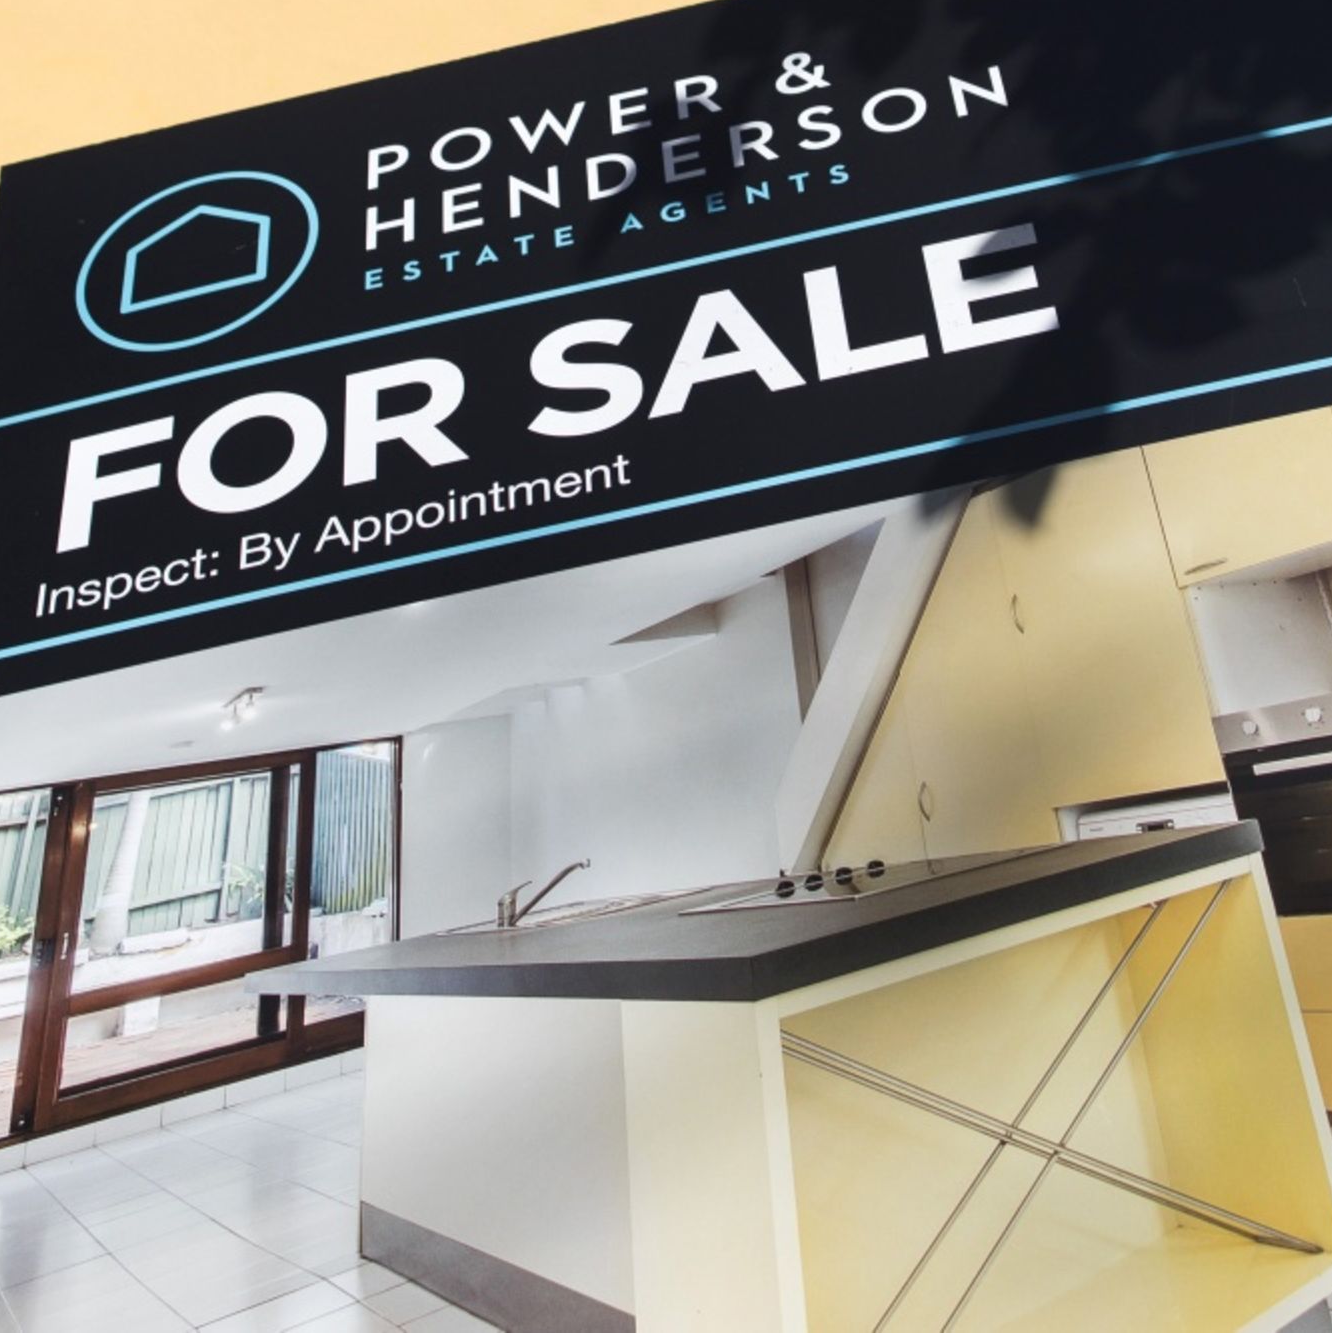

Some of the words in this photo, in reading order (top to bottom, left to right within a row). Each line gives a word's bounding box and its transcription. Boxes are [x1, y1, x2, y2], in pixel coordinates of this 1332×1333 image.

[364, 64, 1009, 252] HENDERSON
[367, 75, 723, 191] POWER
[774, 51, 832, 96] &
[363, 224, 575, 291] ESTATE
[620, 163, 850, 234] AGENTS
[55, 356, 470, 555] FOR
[526, 223, 1060, 438] SALE
[34, 548, 222, 618] Inspect:
[238, 531, 302, 572] By
[313, 453, 632, 554] Appointment
